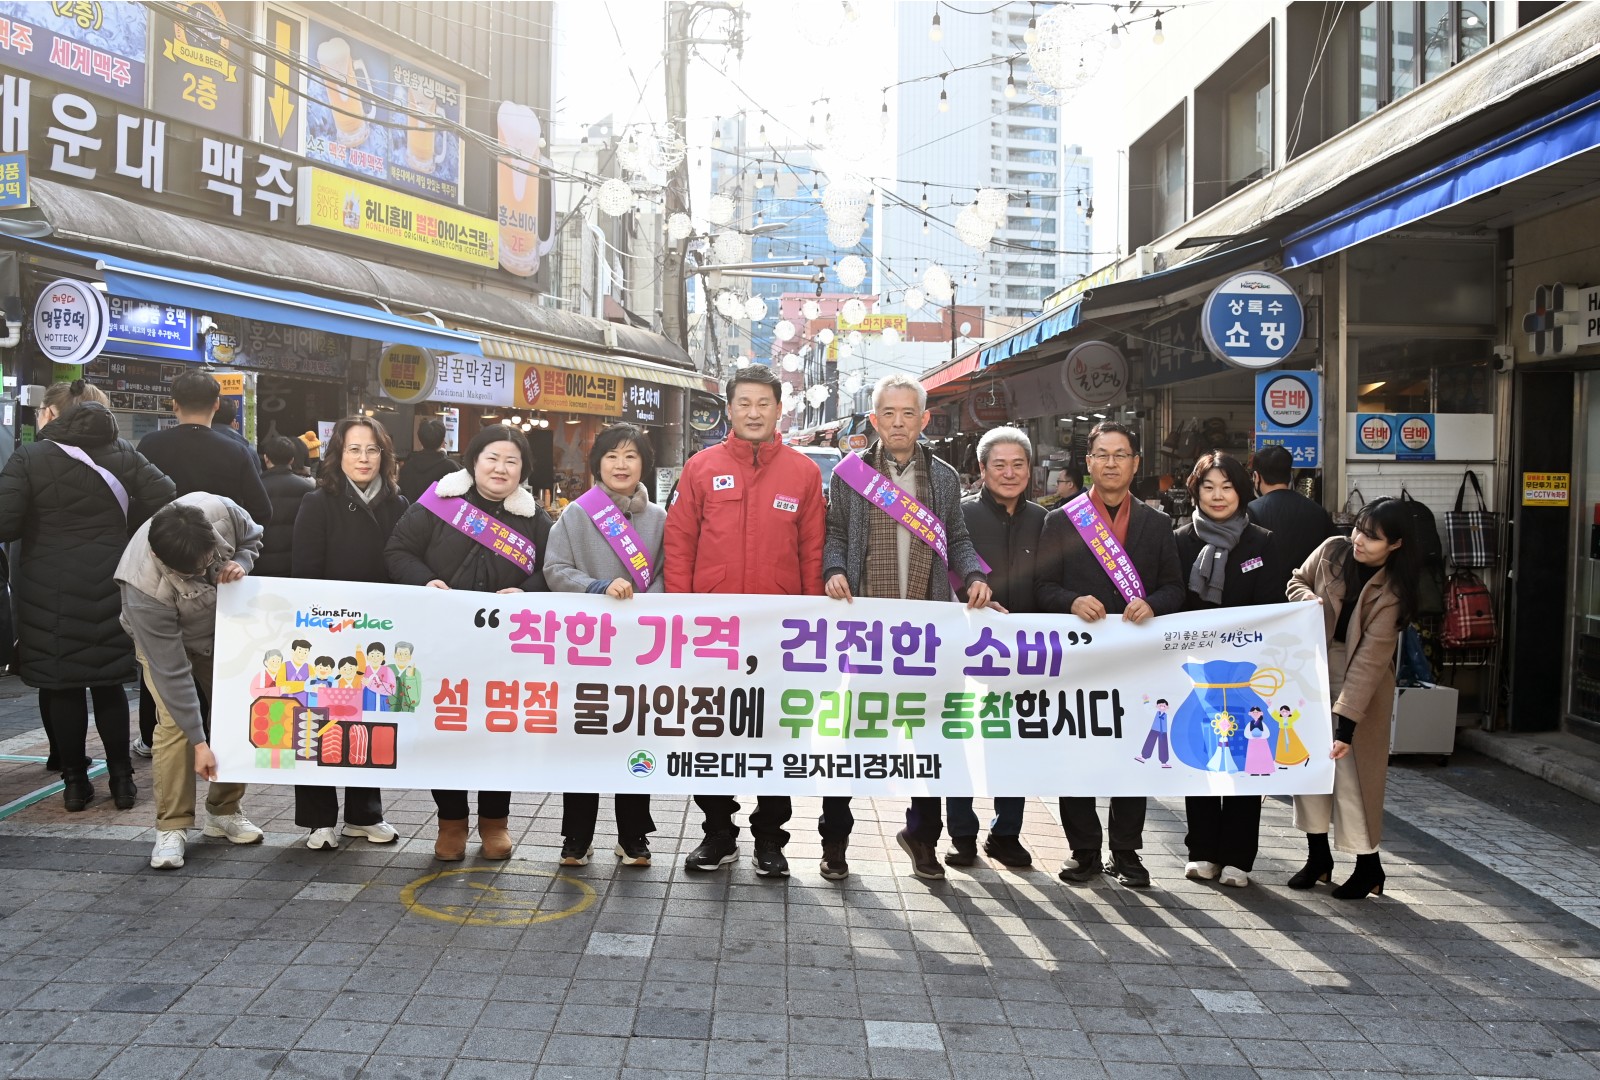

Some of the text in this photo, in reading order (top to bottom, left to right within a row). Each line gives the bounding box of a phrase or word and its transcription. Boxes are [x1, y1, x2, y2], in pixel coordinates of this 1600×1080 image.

[49, 36, 131, 87] 세계맥주
[180, 46, 199, 61] SOJU
[205, 56, 223, 69] BEER
[182, 72, 218, 110] 2층
[307, 134, 384, 173] 소주 맥주 세계맥주
[200, 138, 294, 222] 맥주
[317, 193, 340, 208] SINCE
[317, 203, 340, 220] 2018
[365, 199, 488, 250] 허니홈비 벌집아이스크림
[499, 205, 537, 235] 홍스비어
[404, 230, 430, 244] ORIGINAL
[431, 237, 463, 252] HONEYCOMB
[41, 308, 85, 330] 명품호떡
[104, 296, 133, 321] 운대
[165, 306, 186, 329] 호떡
[1228, 299, 1283, 316] 상록수
[44, 333, 79, 343] HOTTEOK
[212, 333, 236, 348] 생맥주
[1225, 322, 1285, 351] 쇼핑
[435, 356, 505, 389] 벌꿀막걸리
[544, 371, 616, 402] 벌집아이스크림
[630, 385, 660, 409] 타코야끼
[1270, 390, 1305, 409] 담배
[1363, 427, 1388, 440] 담배
[1403, 427, 1428, 440] 담배
[1526, 481, 1552, 489] 무단투기
[1094, 522, 1120, 556] 시장에서
[620, 534, 638, 555] 새해
[630, 551, 648, 570] 복
[1090, 537, 1117, 571] 전통시장
[295, 609, 393, 632] Haeundae
[311, 607, 363, 619] Sun&Fun
[635, 614, 760, 677] 가격,
[780, 618, 942, 677] 건전한
[963, 626, 1093, 678] 소비”
[1179, 642, 1195, 652] 싶은
[1198, 641, 1214, 651] 도시
[1182, 631, 1198, 641] 좋은
[1201, 630, 1218, 640] 도시
[433, 678, 1125, 741] 설 명절 물가안정에 우리모두 동참합시다
[666, 751, 943, 781] 해운대구 일자리경제과
